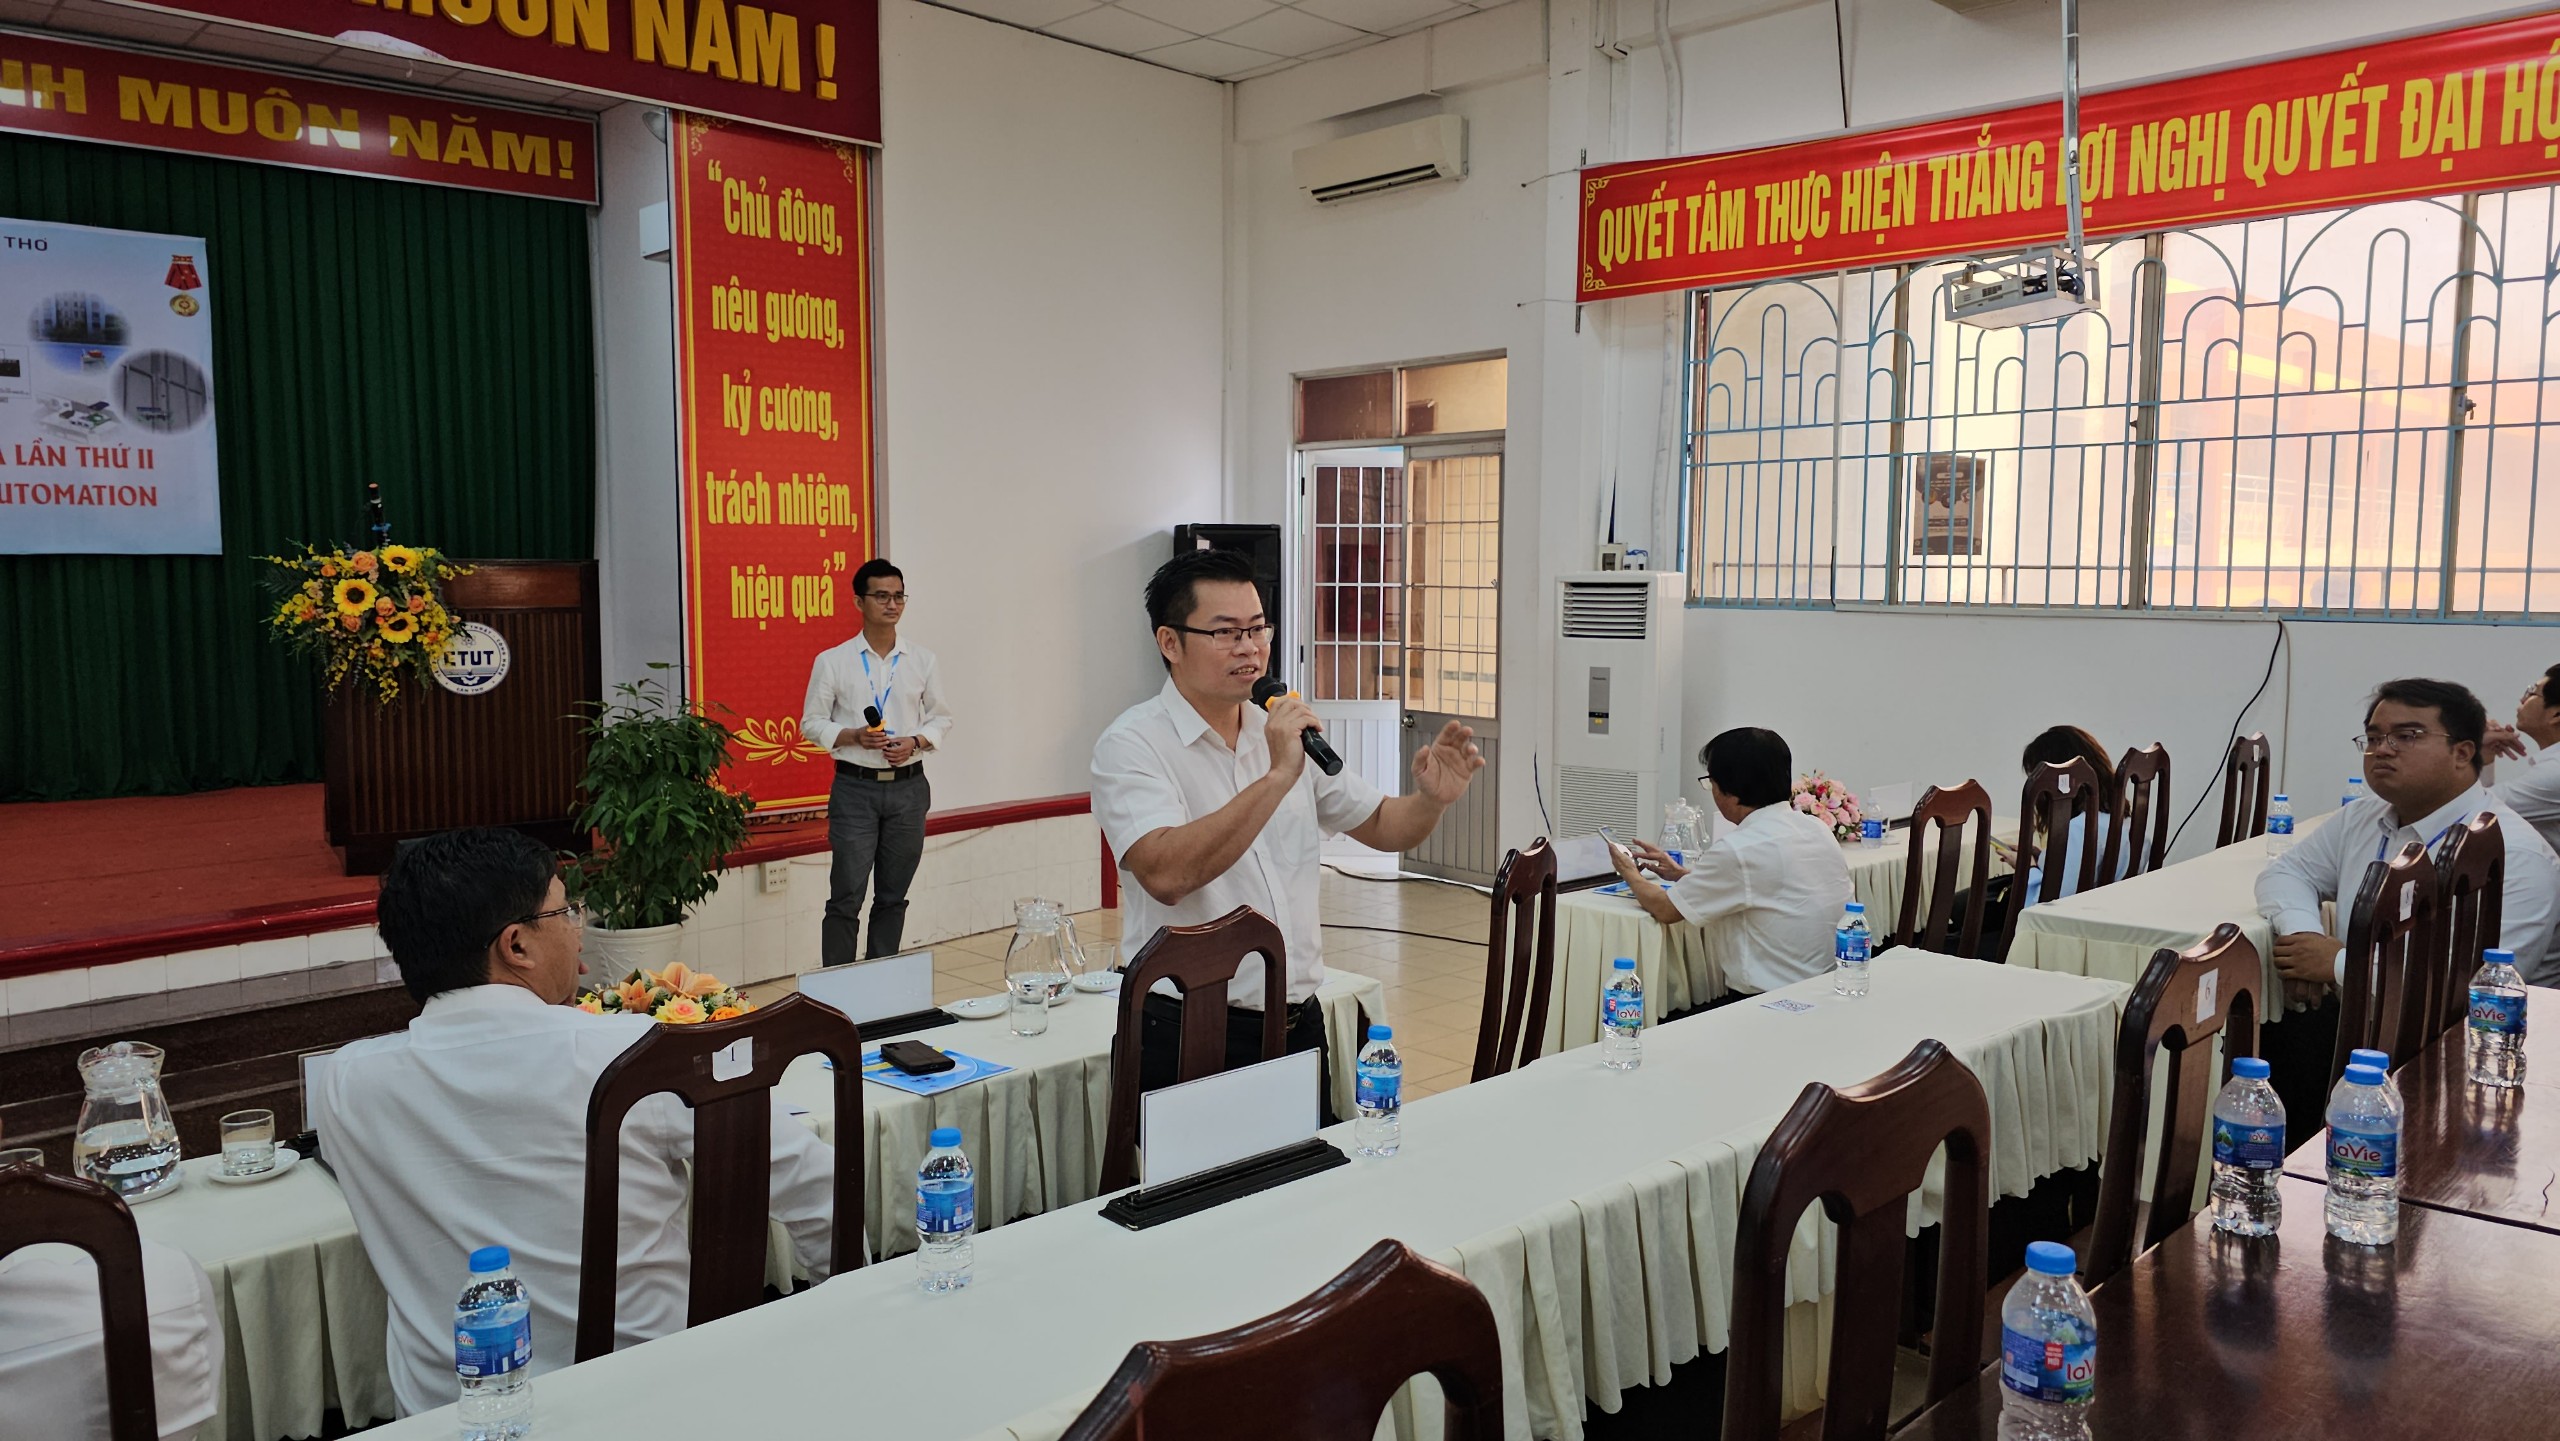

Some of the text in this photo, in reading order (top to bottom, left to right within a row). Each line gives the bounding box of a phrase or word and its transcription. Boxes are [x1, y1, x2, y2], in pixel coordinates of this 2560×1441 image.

[118, 75, 361, 150] MUÔN
[1598, 180, 1679, 272] QUYẾT
[1686, 180, 1746, 255] TÂM
[1755, 170, 1831, 255] THỰC
[1840, 151, 1919, 244] HIỆN
[1928, 123, 2045, 222] THẮNG
[2128, 109, 2231, 202] NGHỊ
[2243, 61, 2389, 188] QUYẾT
[2400, 68, 2487, 172] ĐẠI
[778, 188, 843, 256] động,
[712, 275, 845, 350] nêu gương,
[722, 369, 839, 441] kỷ cương,
[15, 437, 66, 467] LẦN
[75, 442, 131, 469] THỨ
[706, 469, 858, 538] trách nhiệm,
[731, 563, 785, 630] hiệu
